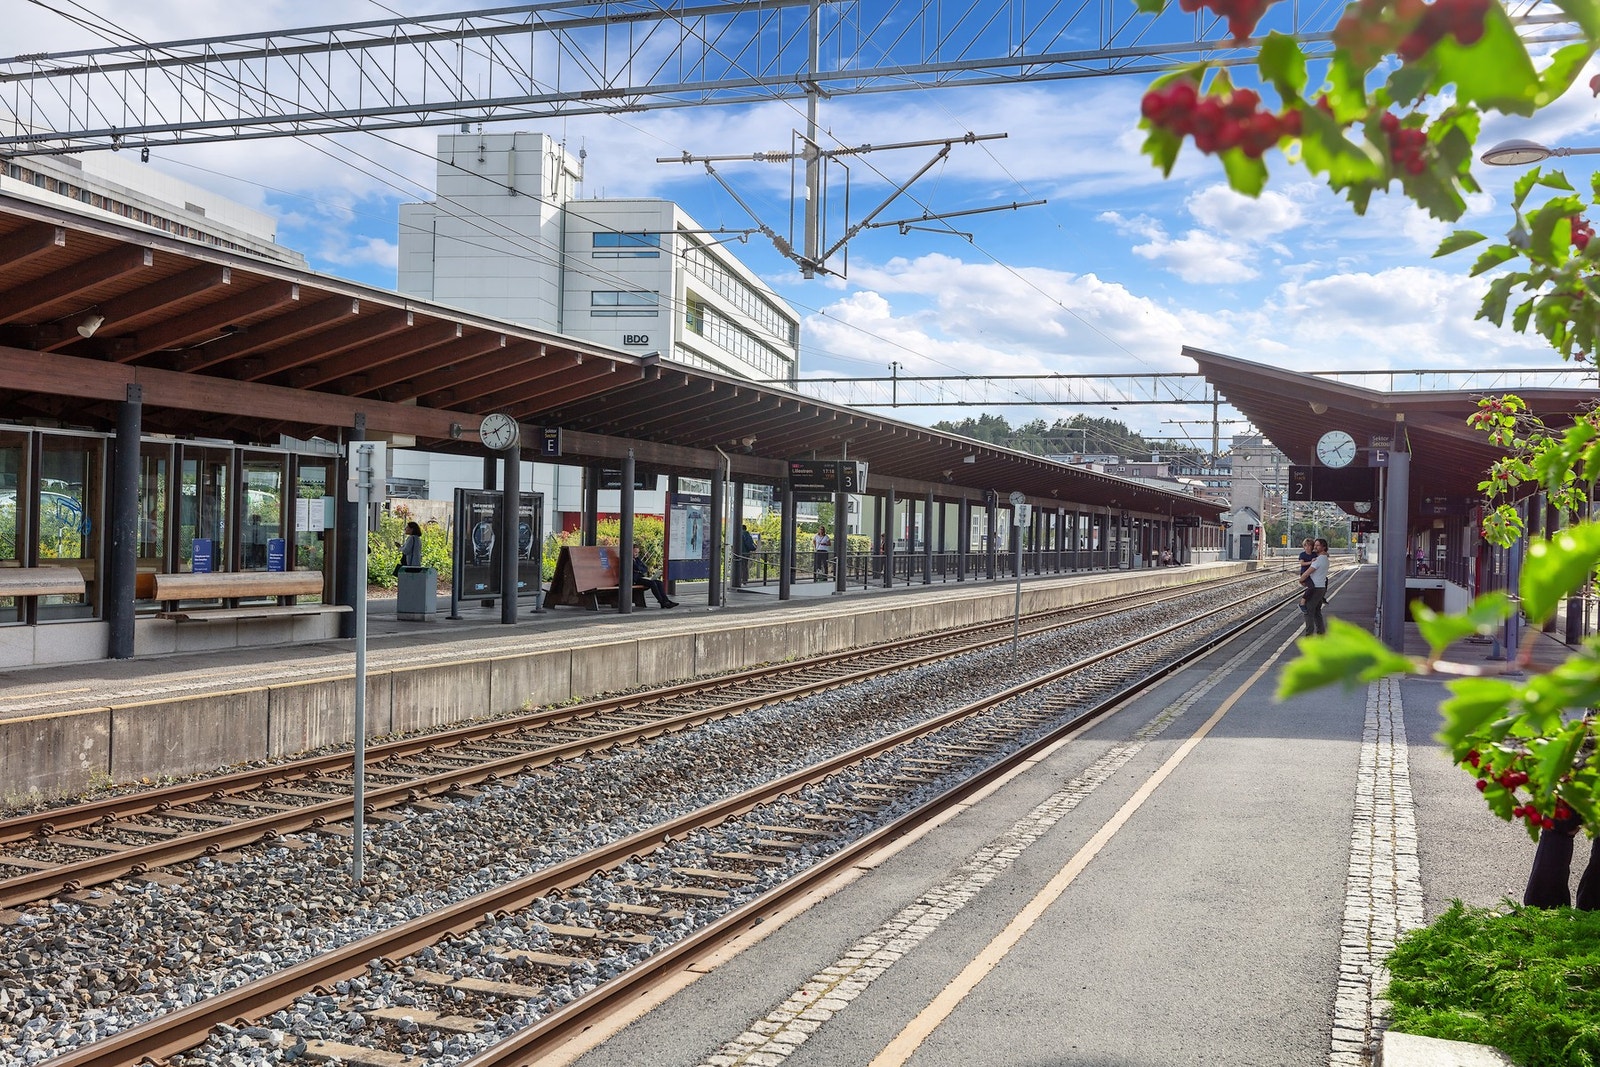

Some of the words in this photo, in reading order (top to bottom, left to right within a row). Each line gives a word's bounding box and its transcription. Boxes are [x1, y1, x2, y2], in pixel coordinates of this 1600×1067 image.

[625, 334, 649, 344] BDO
[548, 440, 554, 452] E
[1376, 450, 1385, 462] E
[846, 476, 852, 487] 3
[1295, 483, 1303, 495] 2
